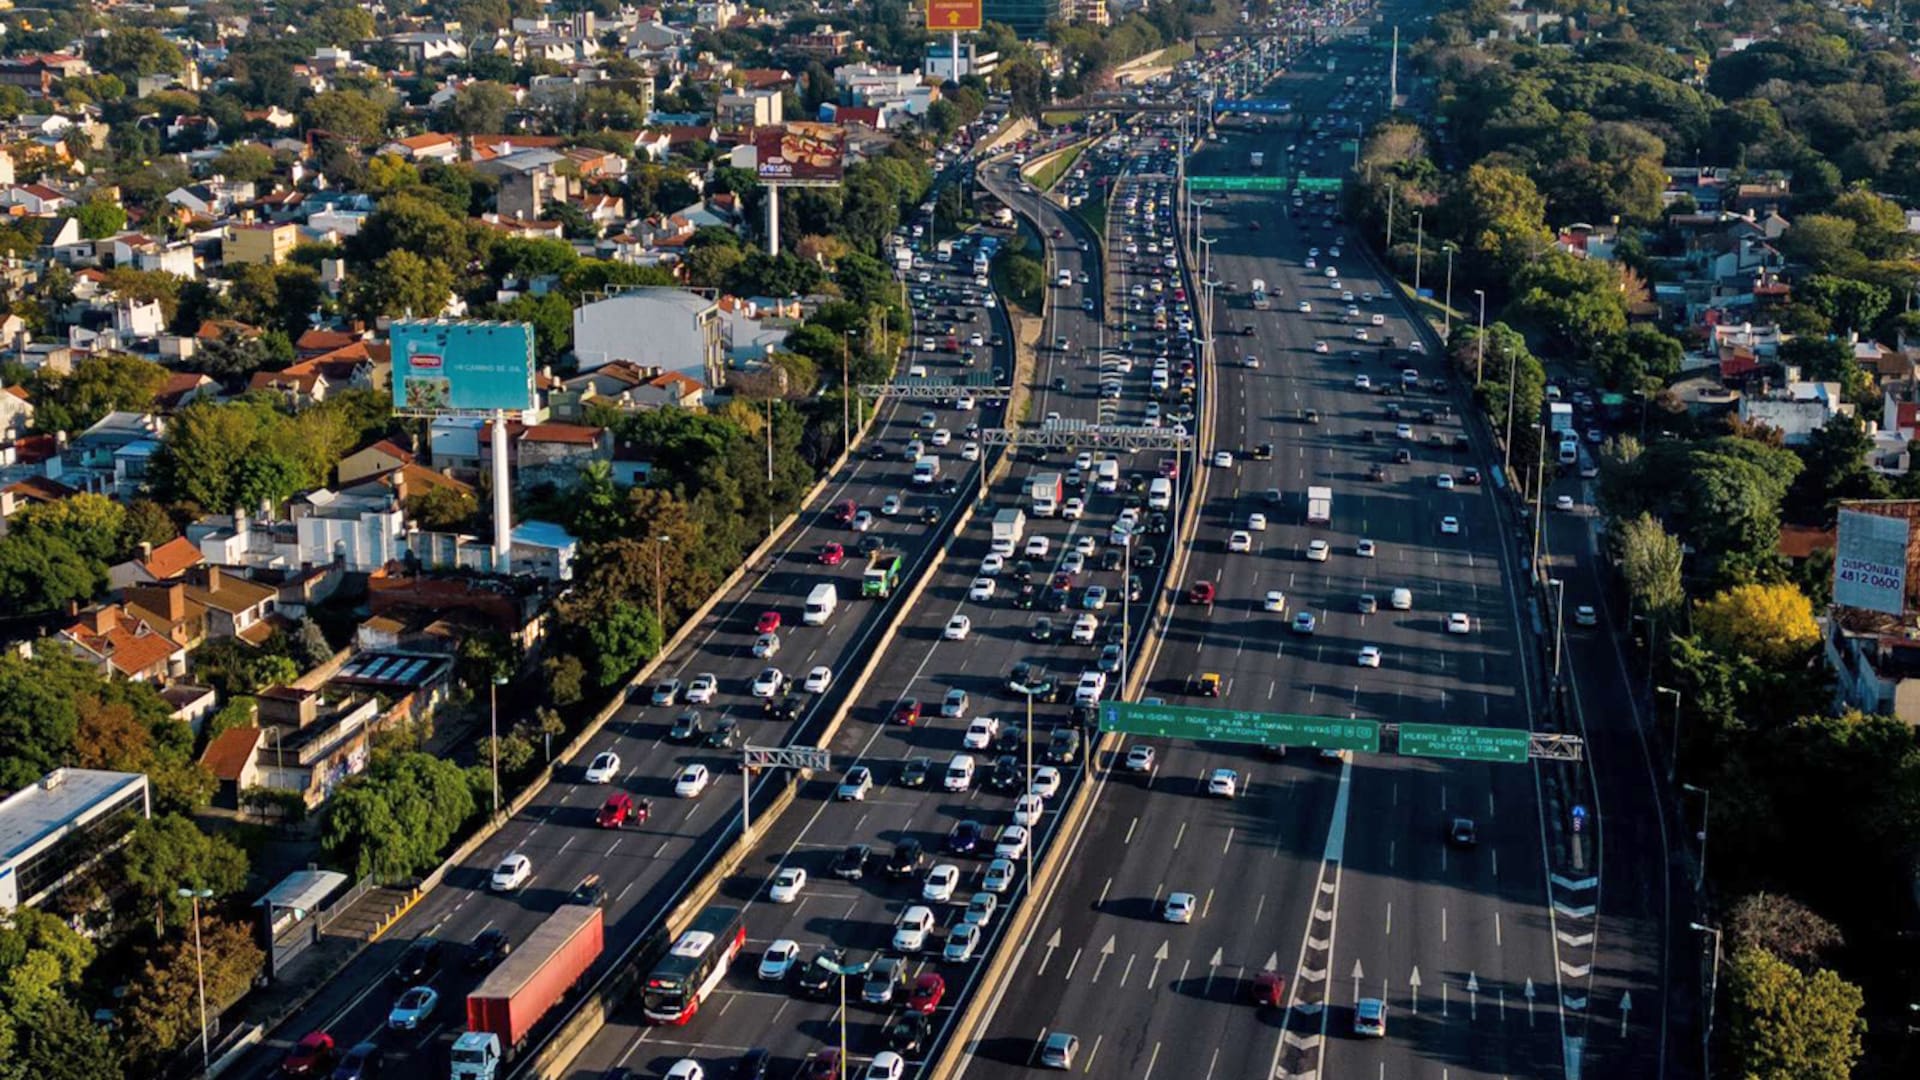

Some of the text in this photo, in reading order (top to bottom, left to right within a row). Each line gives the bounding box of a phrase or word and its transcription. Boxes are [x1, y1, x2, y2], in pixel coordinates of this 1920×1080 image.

[1841, 560, 1899, 577] DISPONIBLE
[1840, 570, 1900, 590] 4812 0600
[1428, 741, 1446, 750] POR
